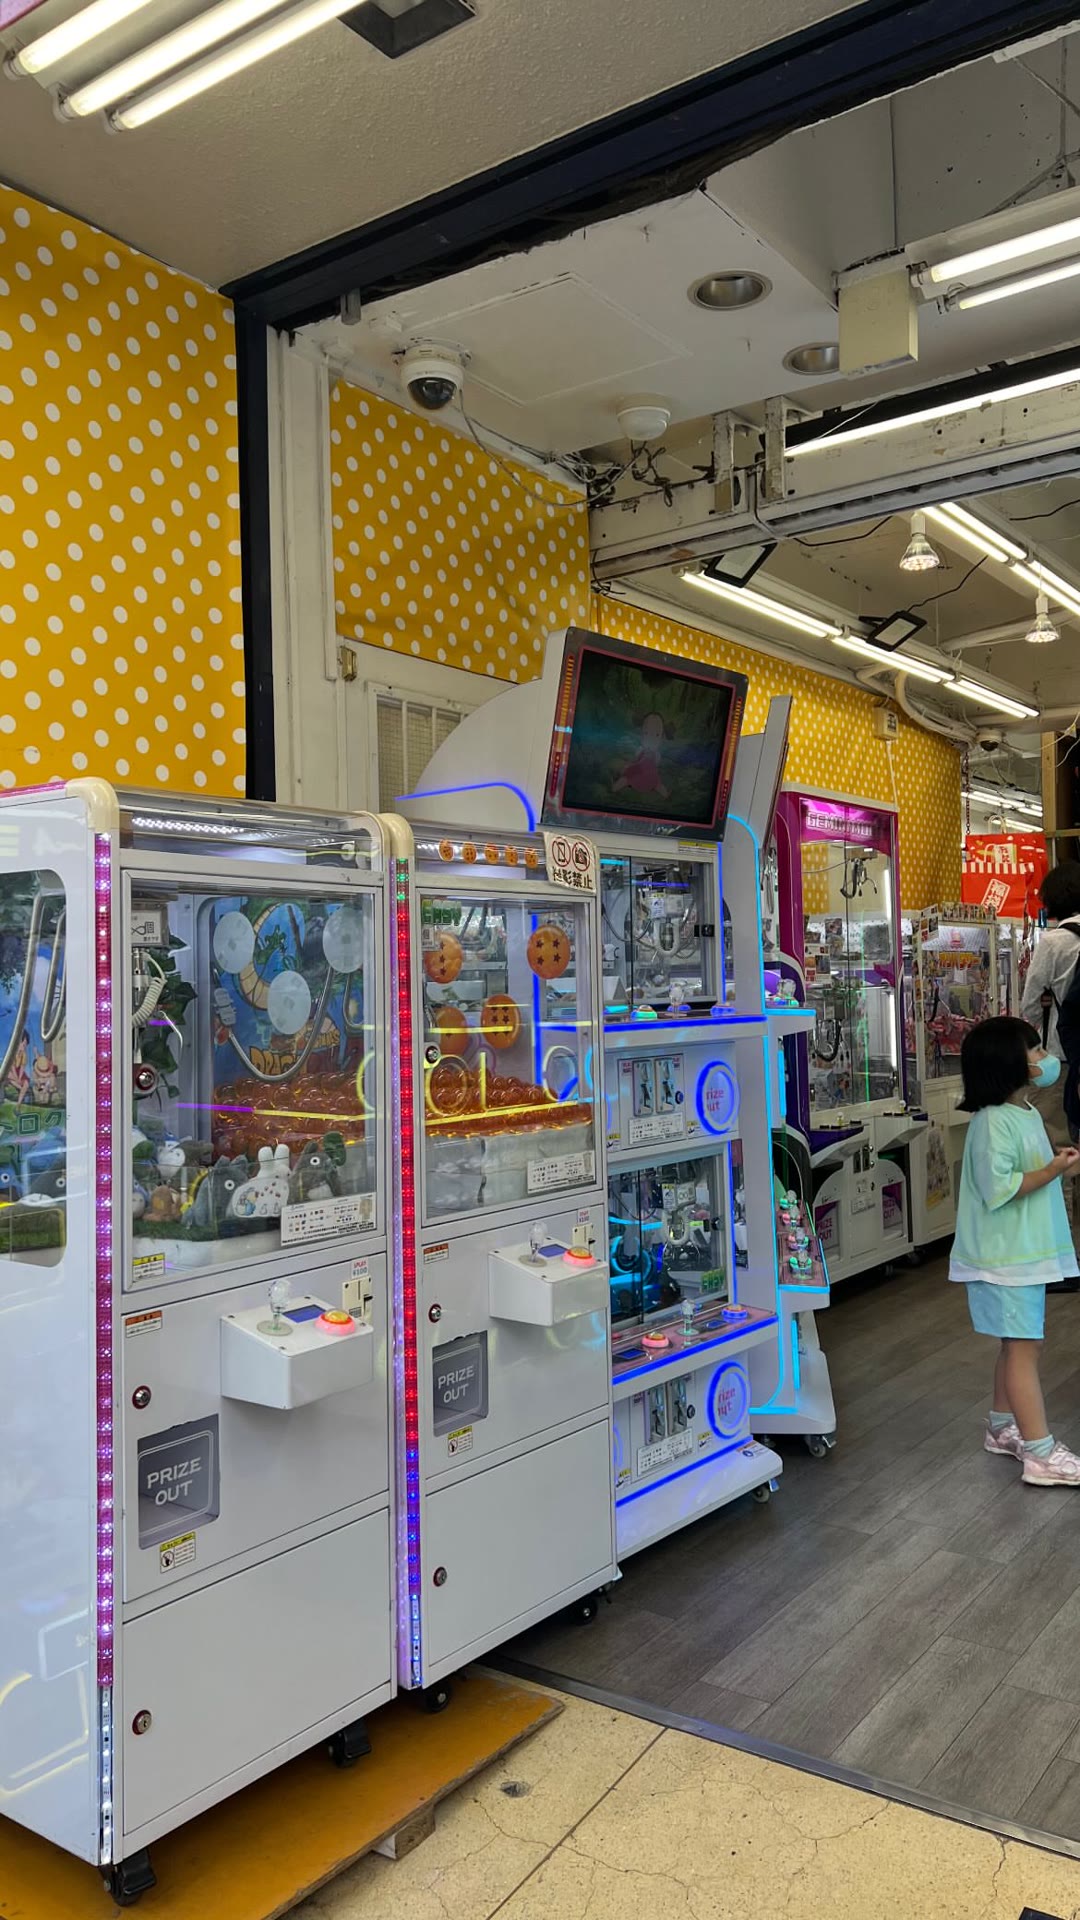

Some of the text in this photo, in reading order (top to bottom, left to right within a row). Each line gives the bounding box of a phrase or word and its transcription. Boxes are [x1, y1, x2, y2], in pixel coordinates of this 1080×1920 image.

[438, 1364, 475, 1388] PRIZE
[443, 1383, 469, 1404] OUT
[147, 1457, 202, 1489] PRIZE
[155, 1480, 193, 1506] OUT
